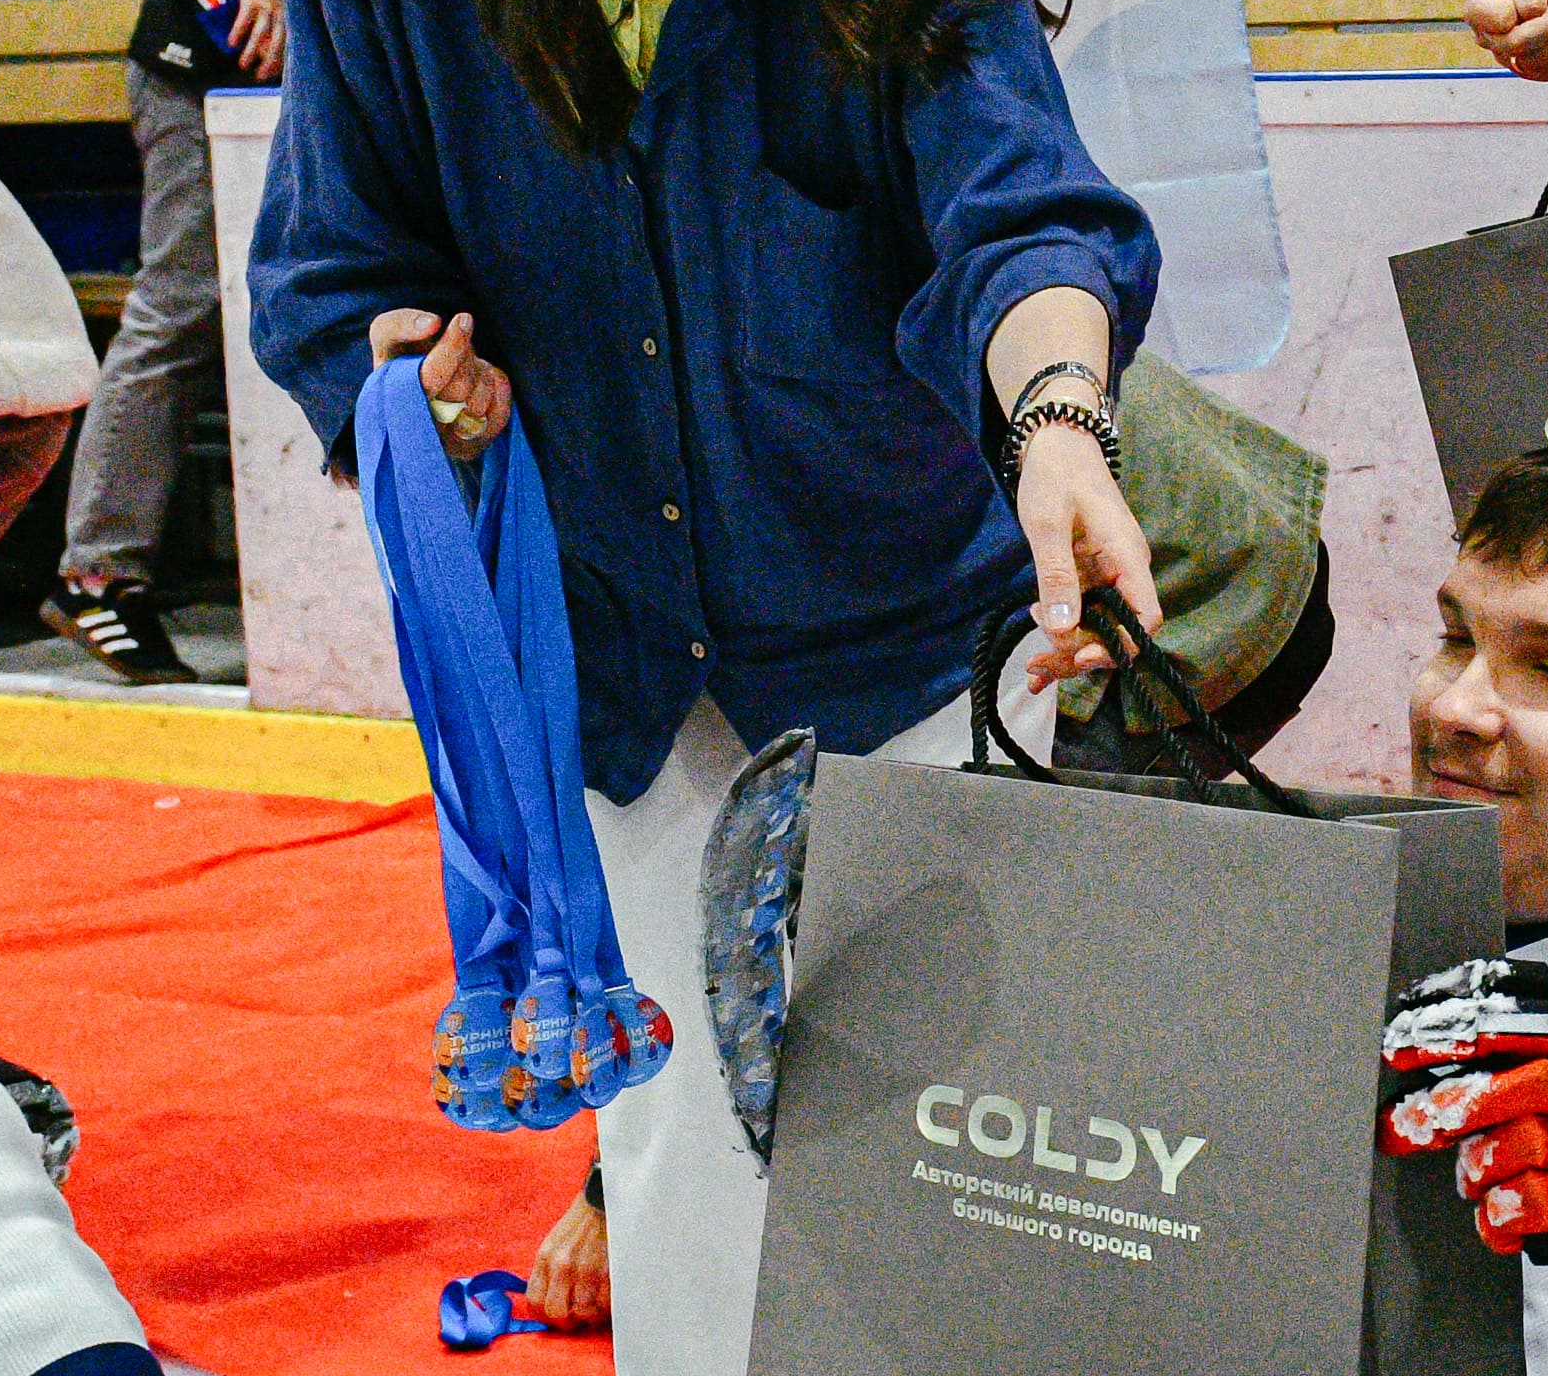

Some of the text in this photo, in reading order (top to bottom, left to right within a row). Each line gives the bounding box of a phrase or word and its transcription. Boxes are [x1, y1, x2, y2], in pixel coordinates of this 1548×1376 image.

[915, 1085, 1206, 1195] COLDY
[912, 1160, 1200, 1242] Авторский девелопмент
[952, 1197, 1152, 1262] большого города
